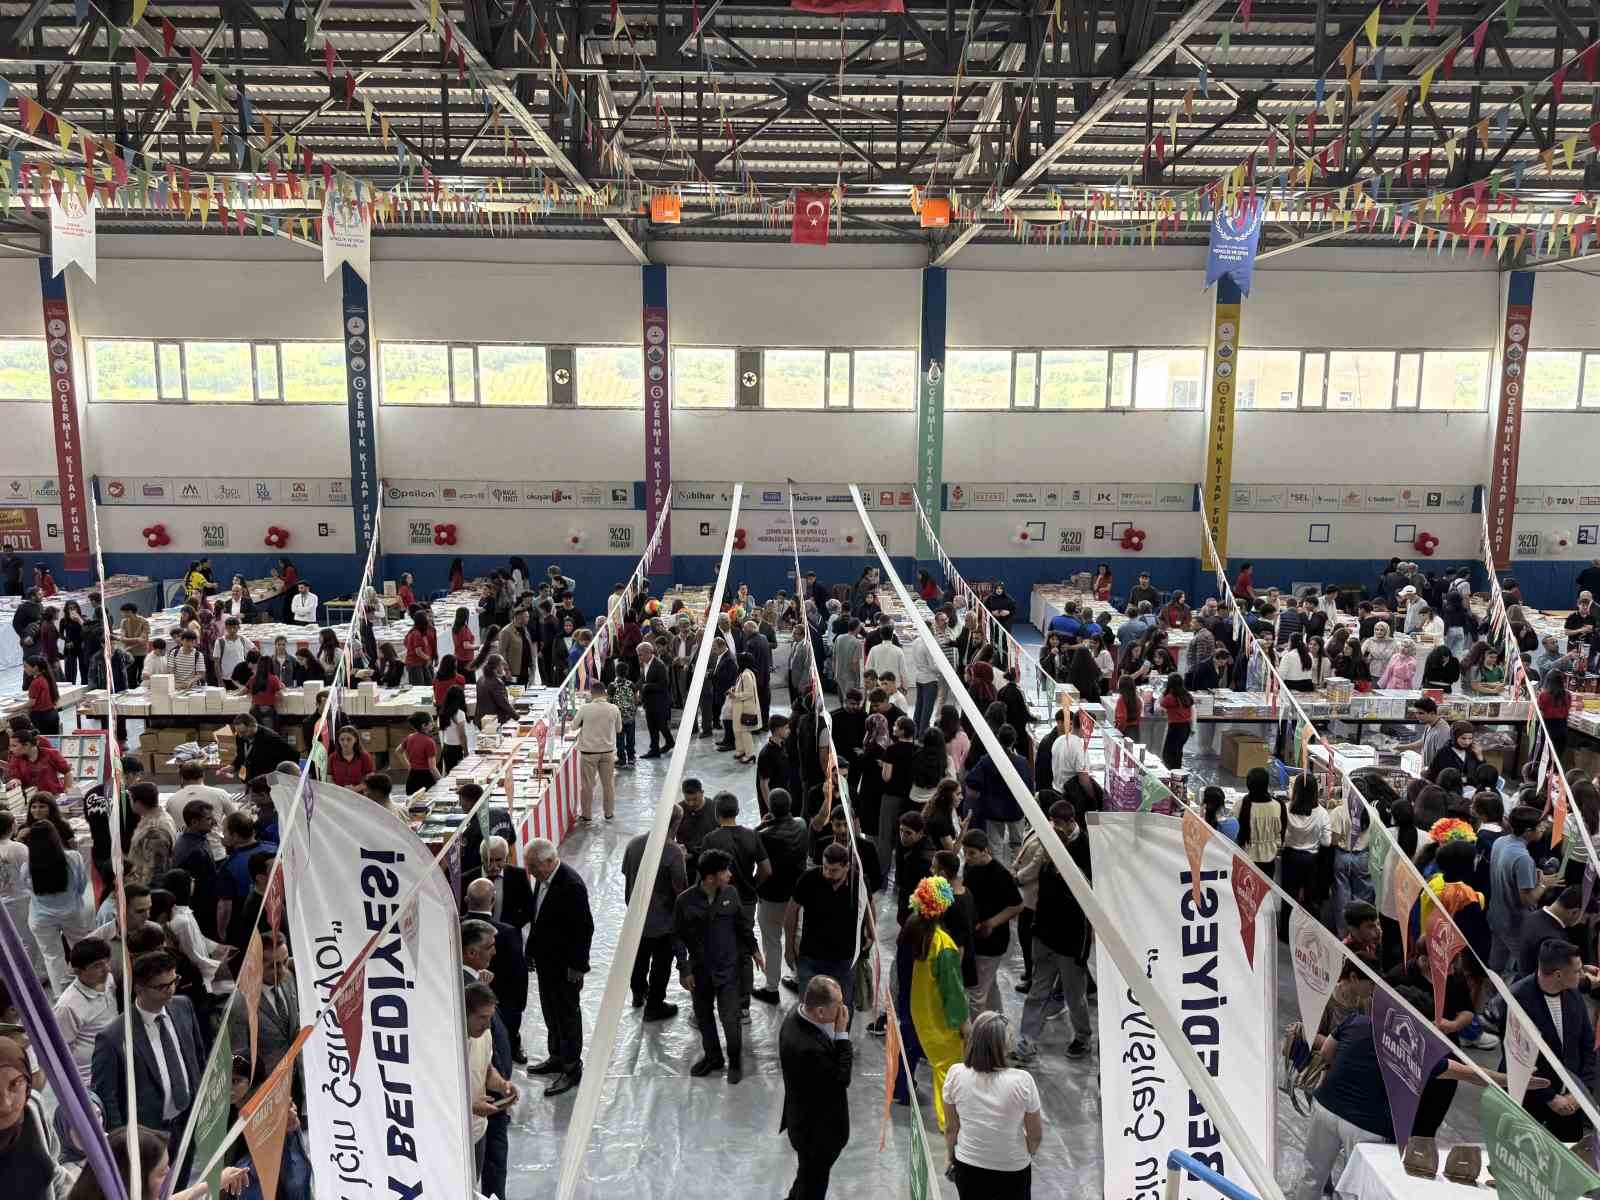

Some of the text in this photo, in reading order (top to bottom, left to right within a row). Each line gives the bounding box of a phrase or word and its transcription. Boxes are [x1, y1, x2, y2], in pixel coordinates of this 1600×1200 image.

[203, 525, 224, 539] %20
[609, 527, 631, 541] %20
[1210, 508, 1220, 546] FUAR
[1060, 531, 1082, 545] %20
[1518, 534, 1538, 547] %20
